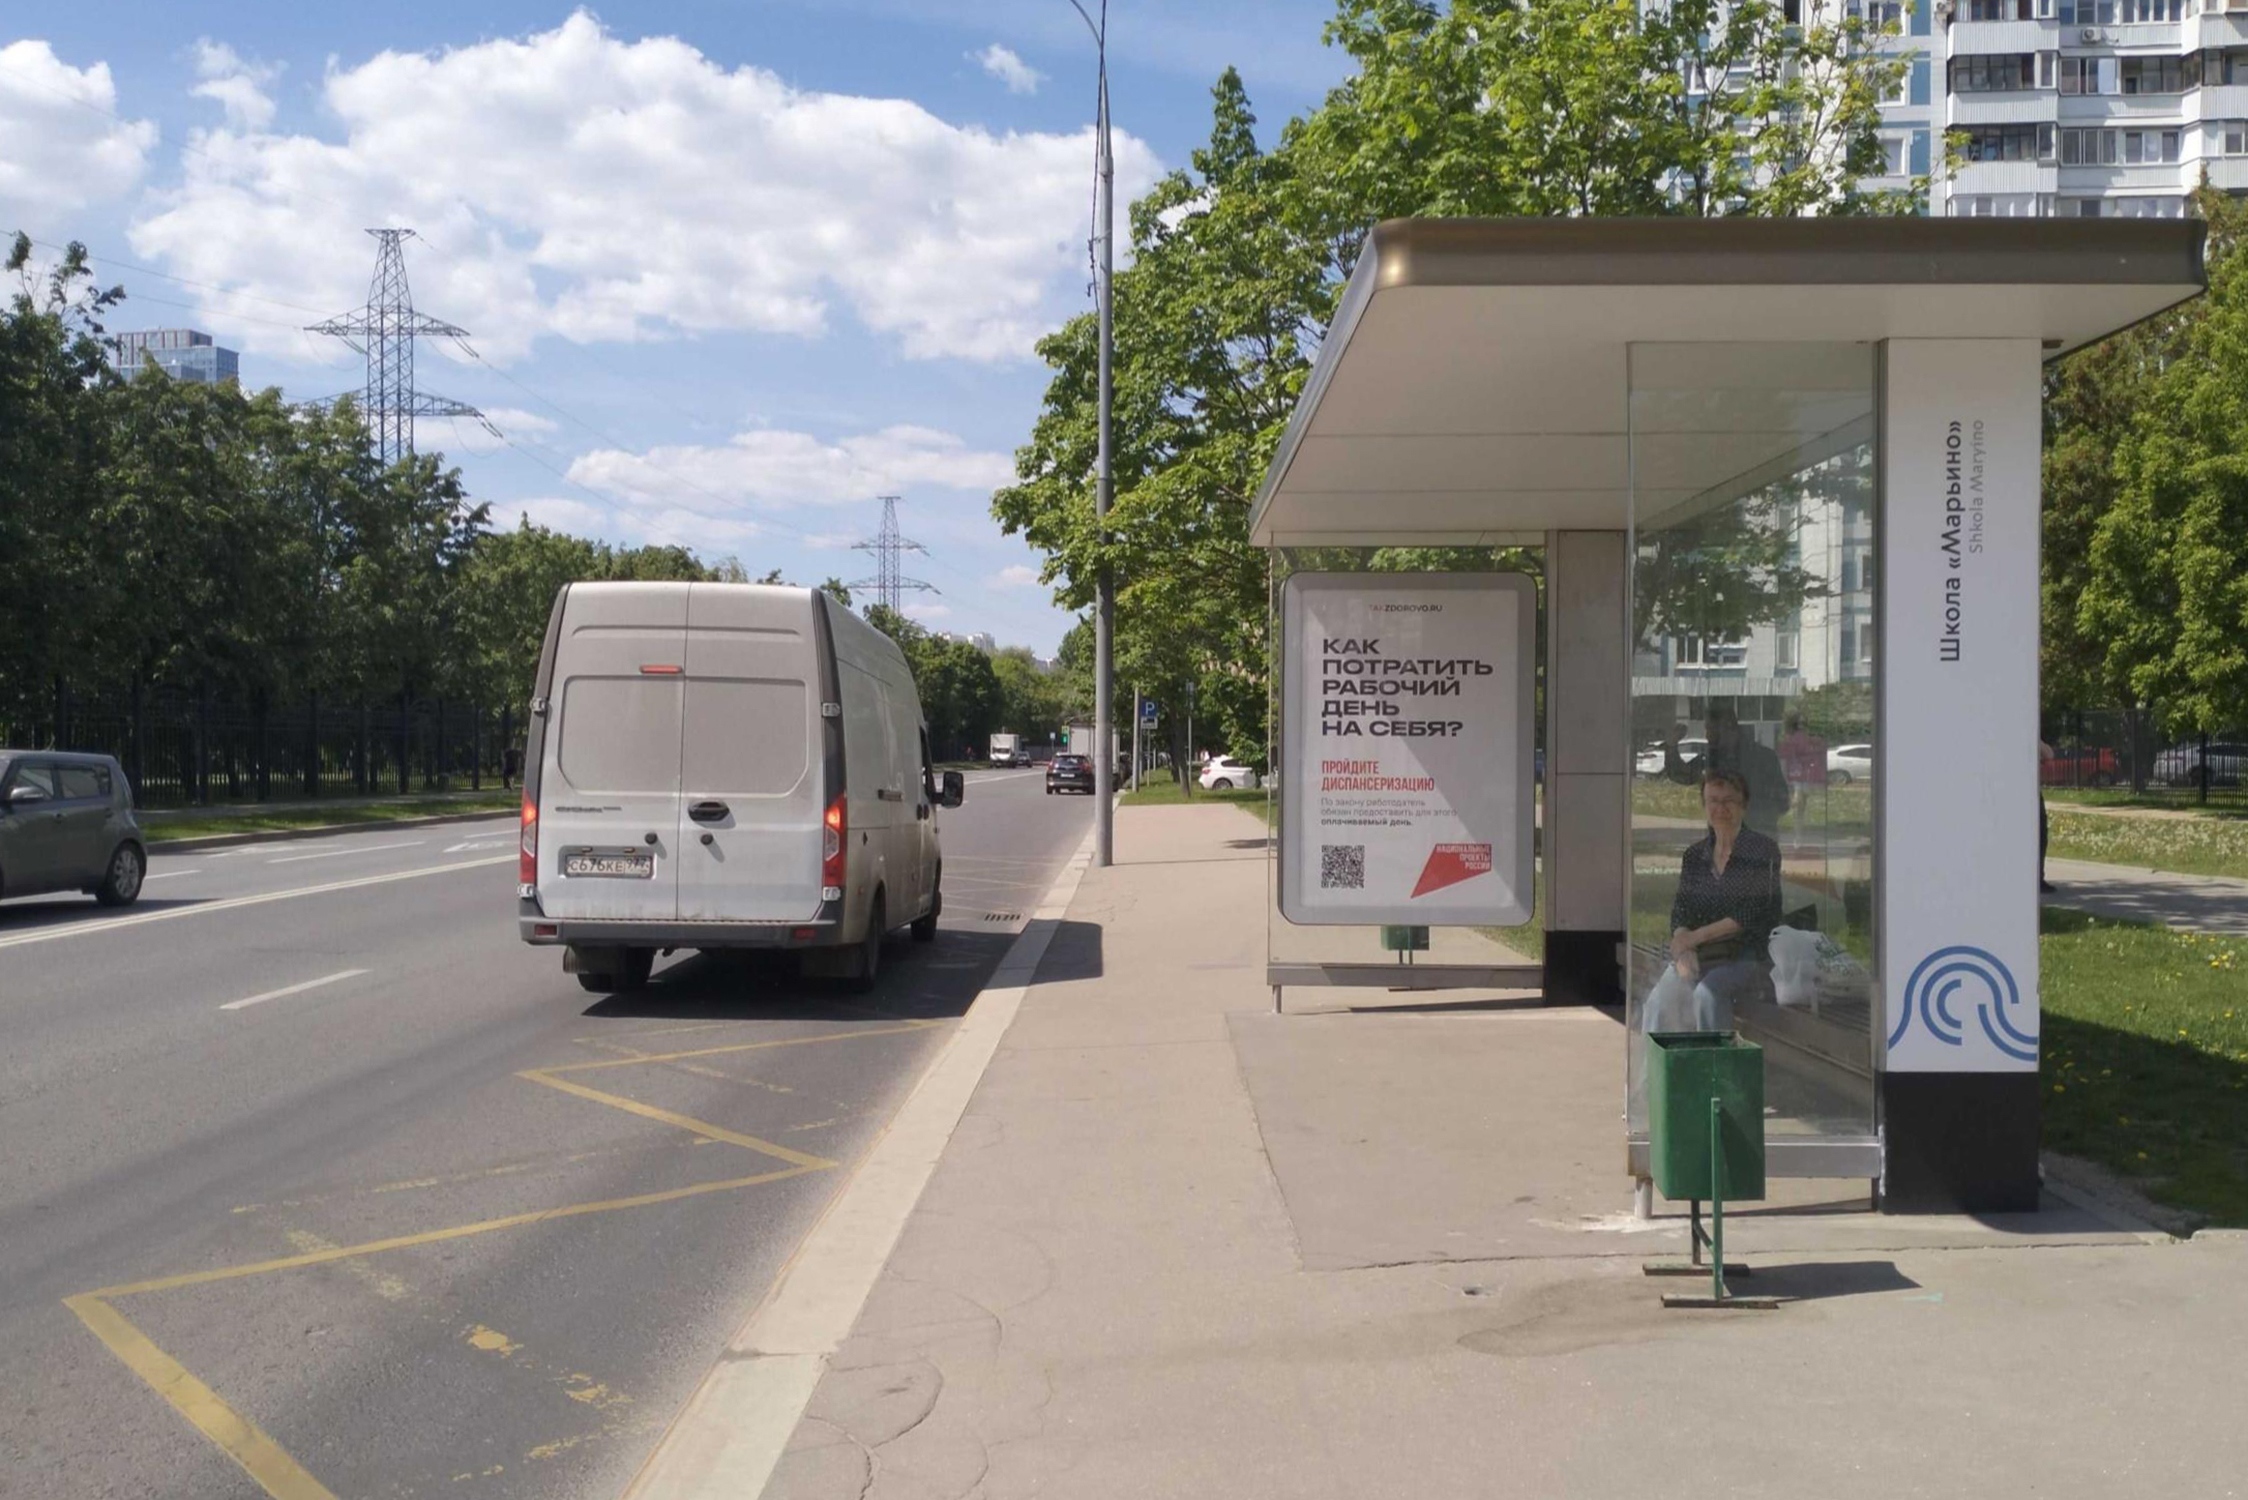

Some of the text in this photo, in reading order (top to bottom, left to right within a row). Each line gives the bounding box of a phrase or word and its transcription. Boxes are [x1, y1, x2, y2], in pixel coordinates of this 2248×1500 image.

[1969, 420, 1986, 553] Shkola Maryino
[1940, 420, 1965, 661] Школа «Марьино»
[1322, 638, 1381, 655] КАК
[1322, 659, 1494, 676] ПОТРАТИТЬ
[1322, 676, 1461, 696] РАБОЧИЙ
[1321, 700, 1400, 719] ДЕНЬ
[1322, 720, 1464, 737] НА СЕБЯ?
[1321, 759, 1380, 776] ПРОЙДИТЕ
[1321, 776, 1435, 793] ДИСПАНСЕРИЗАЦИЮ
[1321, 798, 1426, 808] По закону работодатель
[1321, 808, 1458, 818] обязан предоставить для этого
[1321, 817, 1388, 826] оплачиваемый
[1459, 853, 1491, 861] ПРОЕКТЫ
